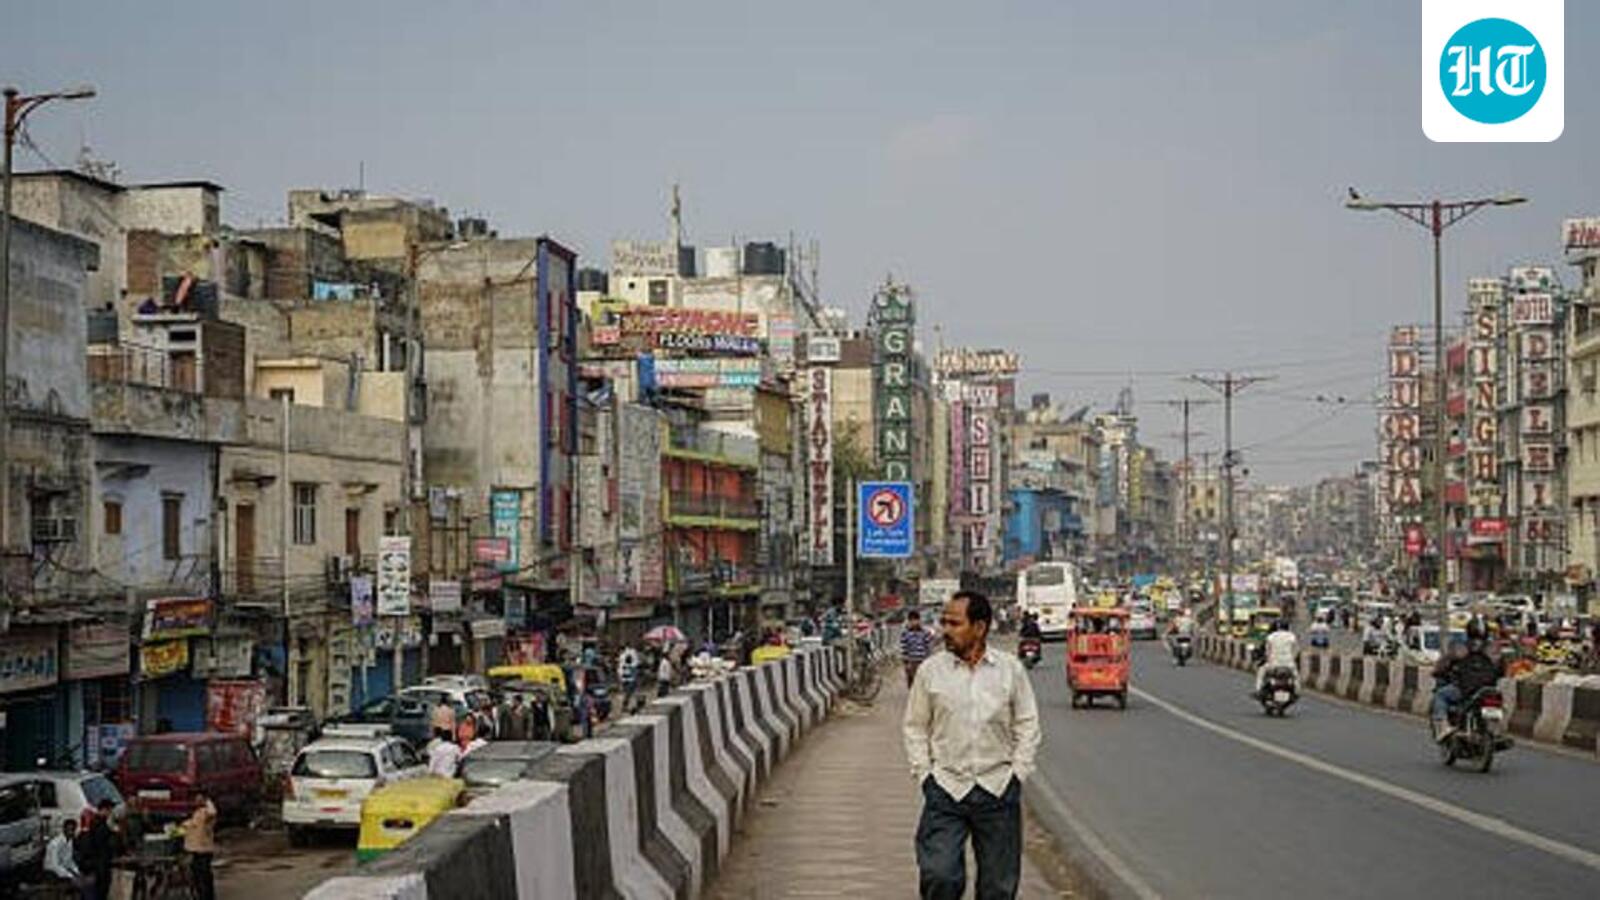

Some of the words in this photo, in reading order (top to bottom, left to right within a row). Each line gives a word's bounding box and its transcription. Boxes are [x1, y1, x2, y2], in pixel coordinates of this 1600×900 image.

[1516, 297, 1549, 321] HOTEL
[884, 331, 906, 480] GRAND
[1392, 350, 1420, 506] DURGA
[1475, 311, 1498, 480] SINGH
